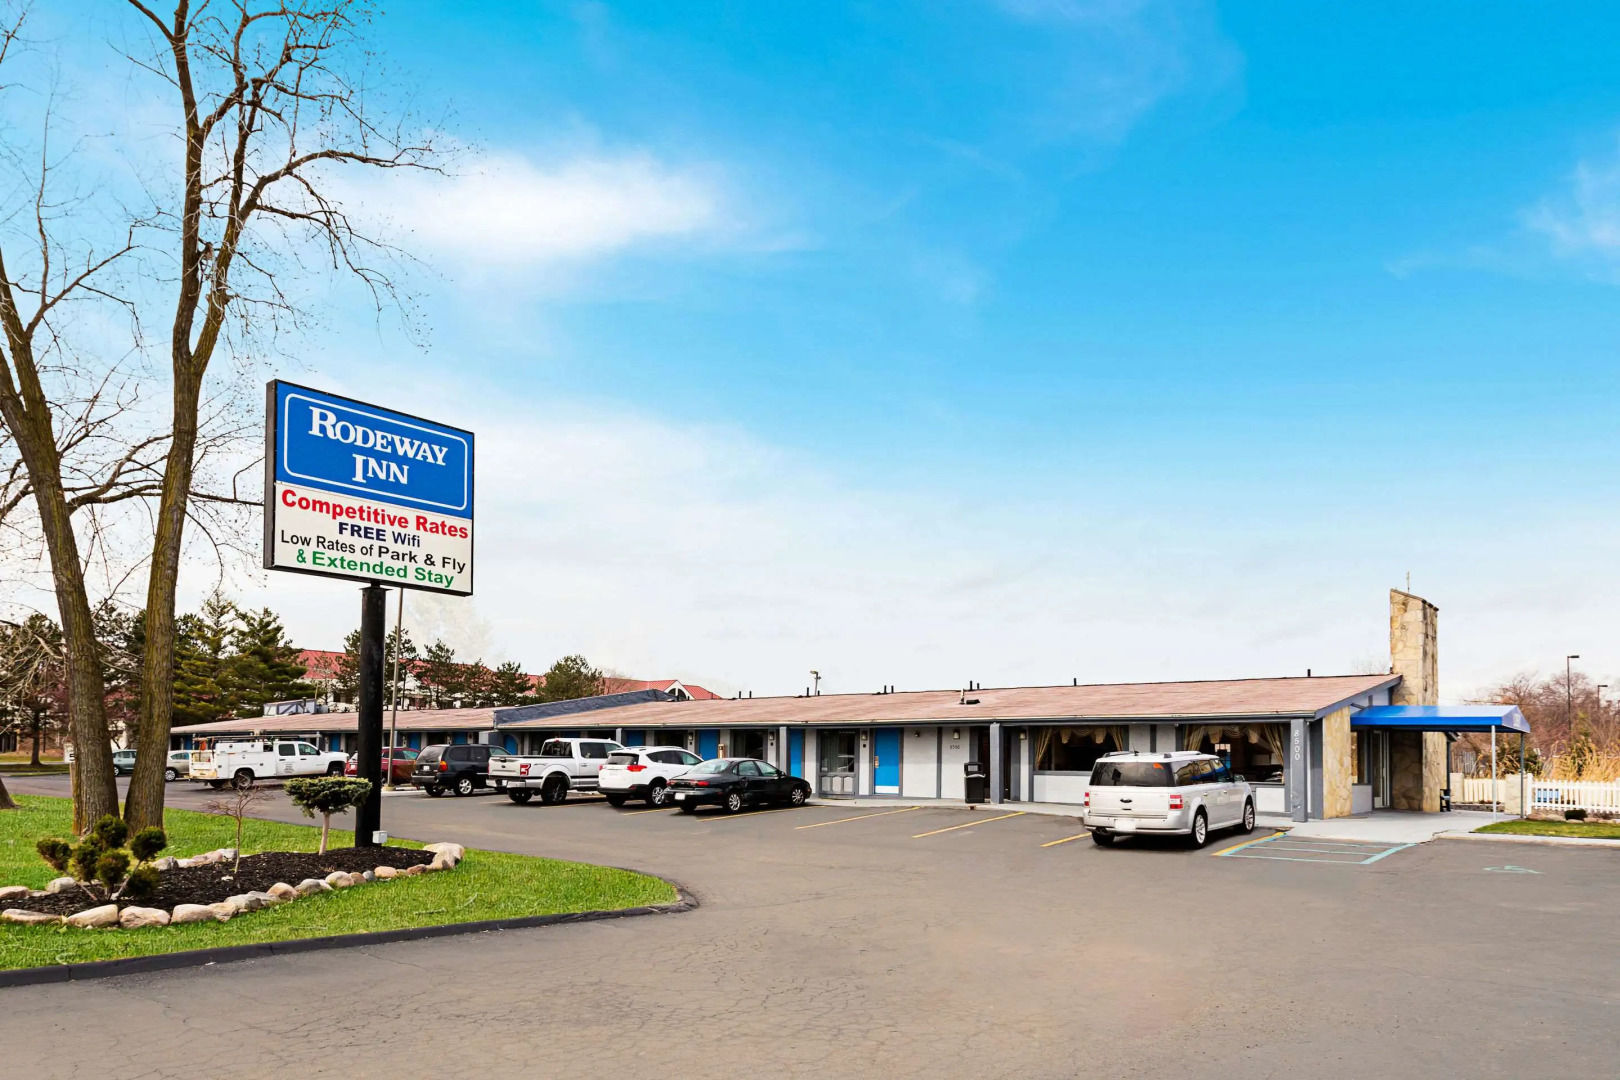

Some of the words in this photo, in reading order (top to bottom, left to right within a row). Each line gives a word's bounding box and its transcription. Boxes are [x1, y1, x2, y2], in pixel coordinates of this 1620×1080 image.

[308, 405, 449, 466] RODEWAY
[351, 453, 409, 485] INN
[281, 488, 410, 530] Competitive
[415, 514, 469, 540] Rates
[338, 521, 387, 542] FREE
[391, 530, 421, 548] Wifi
[280, 529, 312, 547] Low
[316, 535, 356, 554] Rates
[360, 544, 375, 557] of
[378, 545, 418, 564] Park
[423, 553, 436, 567] &
[442, 556, 466, 574] Fly
[296, 548, 307, 565] &
[311, 550, 408, 579] Extended
[414, 567, 455, 588] Stay
